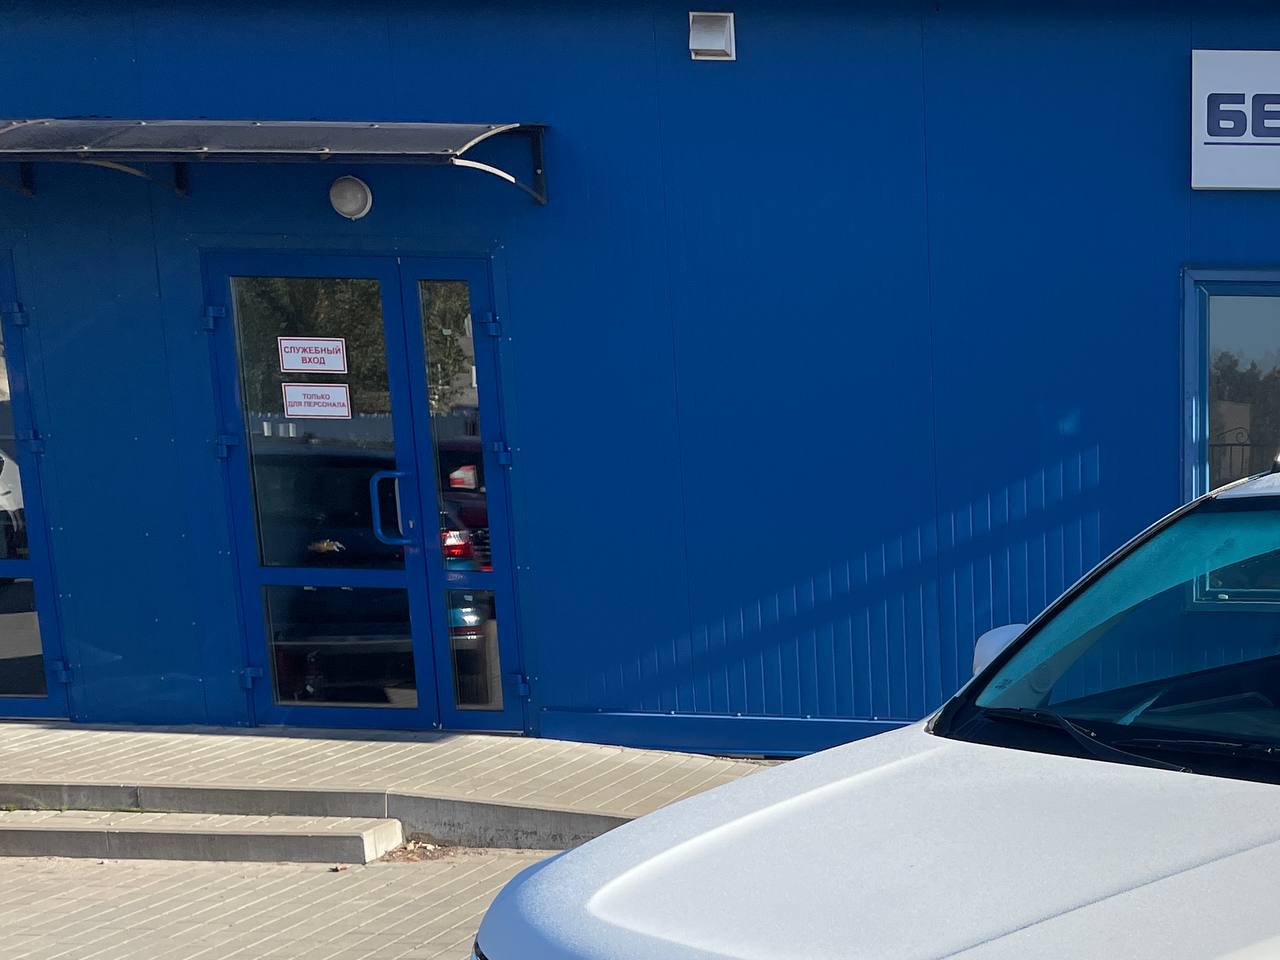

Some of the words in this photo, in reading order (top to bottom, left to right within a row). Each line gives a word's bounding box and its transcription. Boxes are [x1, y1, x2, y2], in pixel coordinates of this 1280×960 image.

[283, 345, 341, 355] СЛУЖЕБНЫЙ
[301, 356, 326, 365] ВХОД
[302, 393, 331, 401] ТОЛЬКО
[304, 401, 347, 409] ПЕРСОНАЛА
